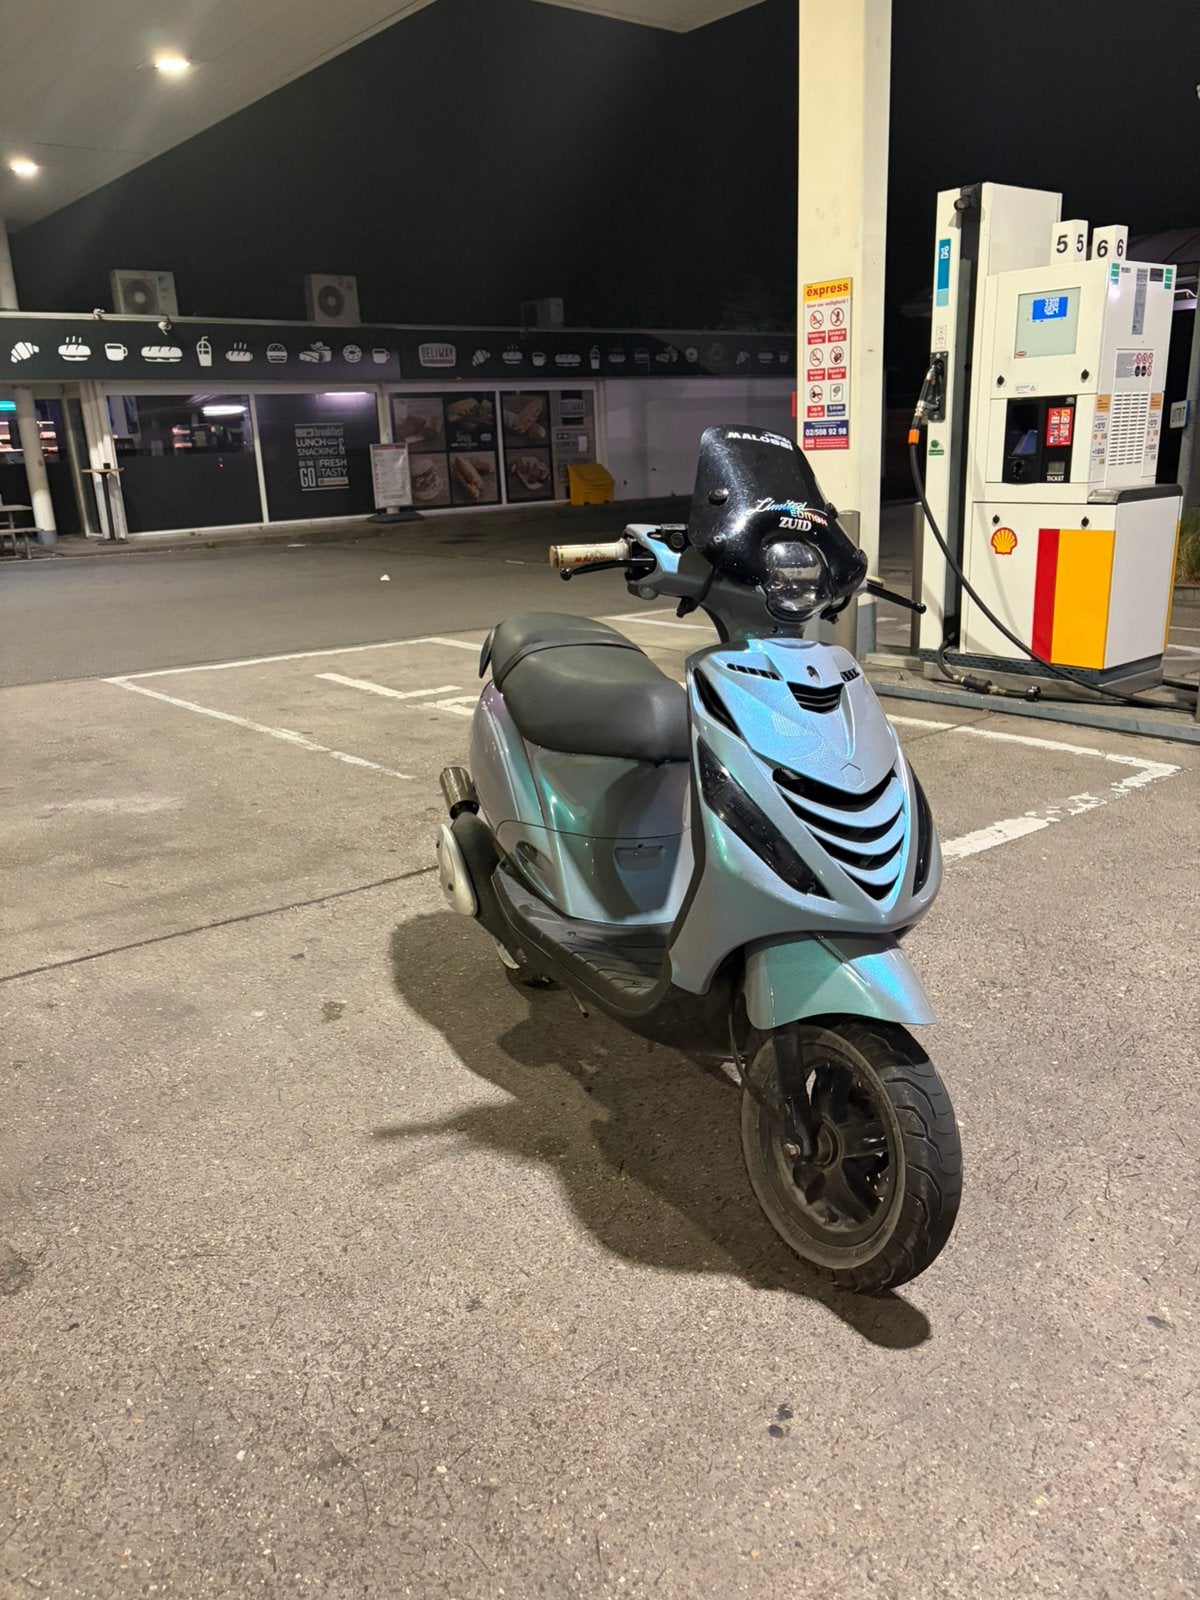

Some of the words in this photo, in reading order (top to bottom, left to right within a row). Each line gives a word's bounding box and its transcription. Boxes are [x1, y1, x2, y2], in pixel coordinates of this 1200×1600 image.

[1056, 235, 1068, 253] 5
[1076, 234, 1084, 252] 5
[1097, 239, 1109, 257] 6
[1117, 239, 1124, 257] 6
[806, 282, 849, 297] express
[727, 431, 794, 451] MALOSSI
[805, 428, 827, 437] 02/508
[828, 428, 837, 436] 92
[838, 427, 847, 435] 98
[296, 438, 326, 447] LUNCH
[297, 447, 338, 456] SNACKING
[320, 458, 347, 467] FRESH
[320, 467, 347, 476] TASTY
[300, 467, 317, 487] GO
[745, 497, 808, 515] Limited
[778, 516, 812, 532] ZUID
[790, 509, 828, 527] EDITION
